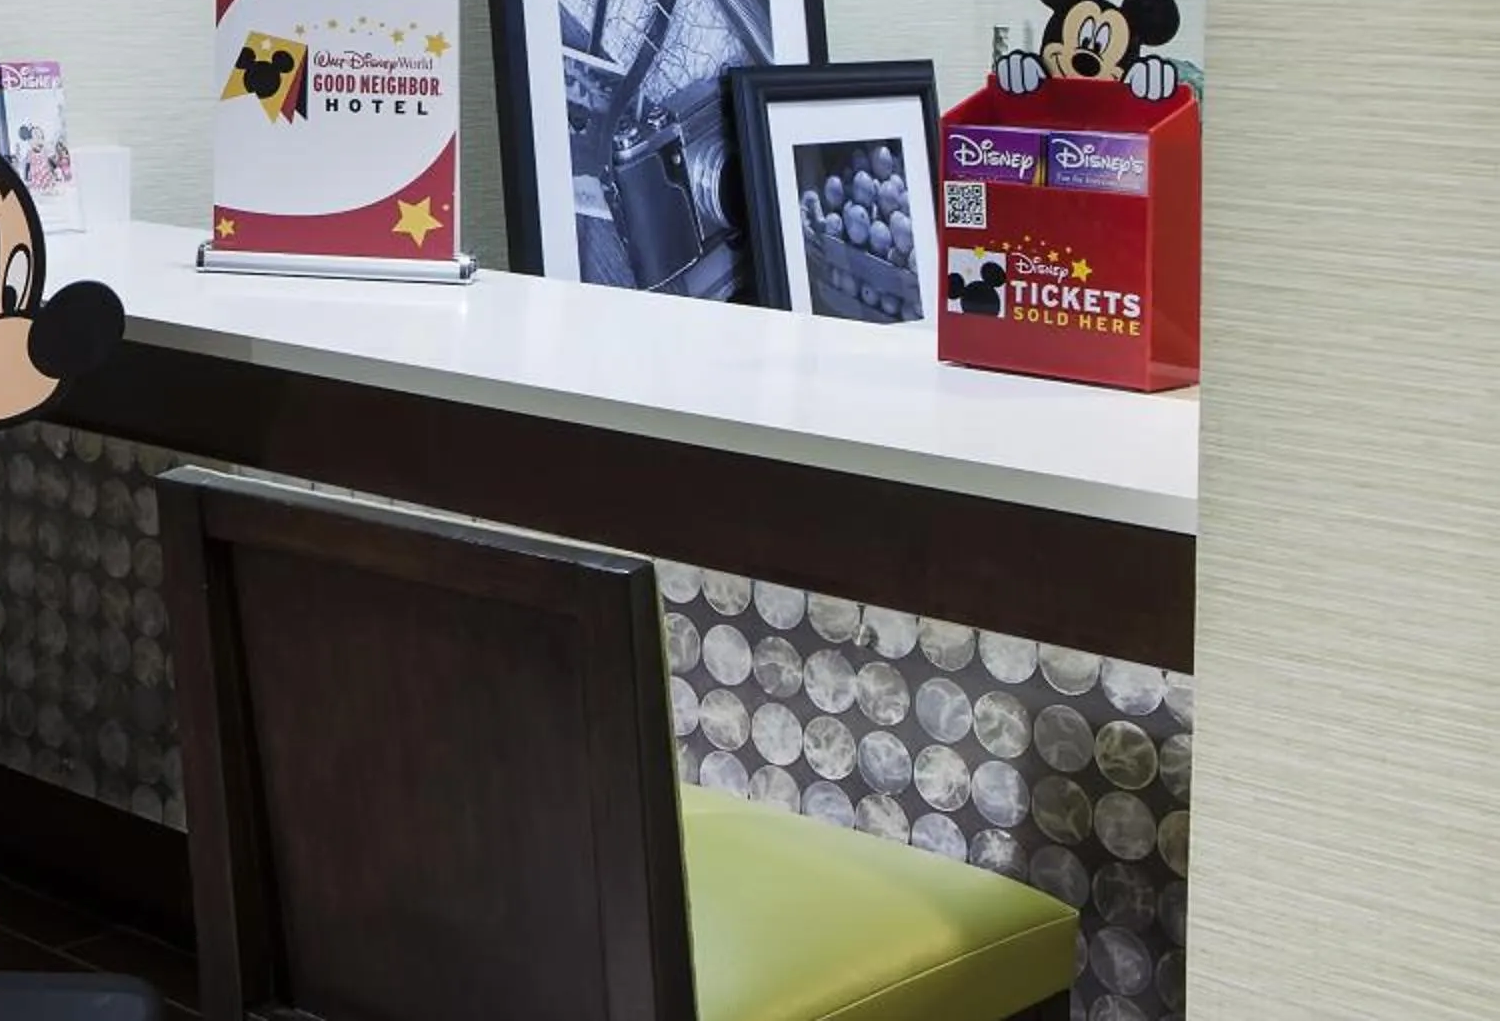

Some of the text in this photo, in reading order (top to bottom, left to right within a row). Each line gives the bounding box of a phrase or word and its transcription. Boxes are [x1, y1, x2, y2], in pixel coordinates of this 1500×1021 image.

[313, 50, 433, 74] Walt Disney World
[313, 74, 441, 96] GOOD NEIGHBOR
[325, 99, 428, 115] HOTEL
[948, 134, 1034, 179] Disney
[1052, 138, 1145, 181] Disney's
[1010, 252, 1068, 283] Disney
[1010, 280, 1141, 318] TICKETS
[1013, 307, 1141, 336] SOLD HERE
